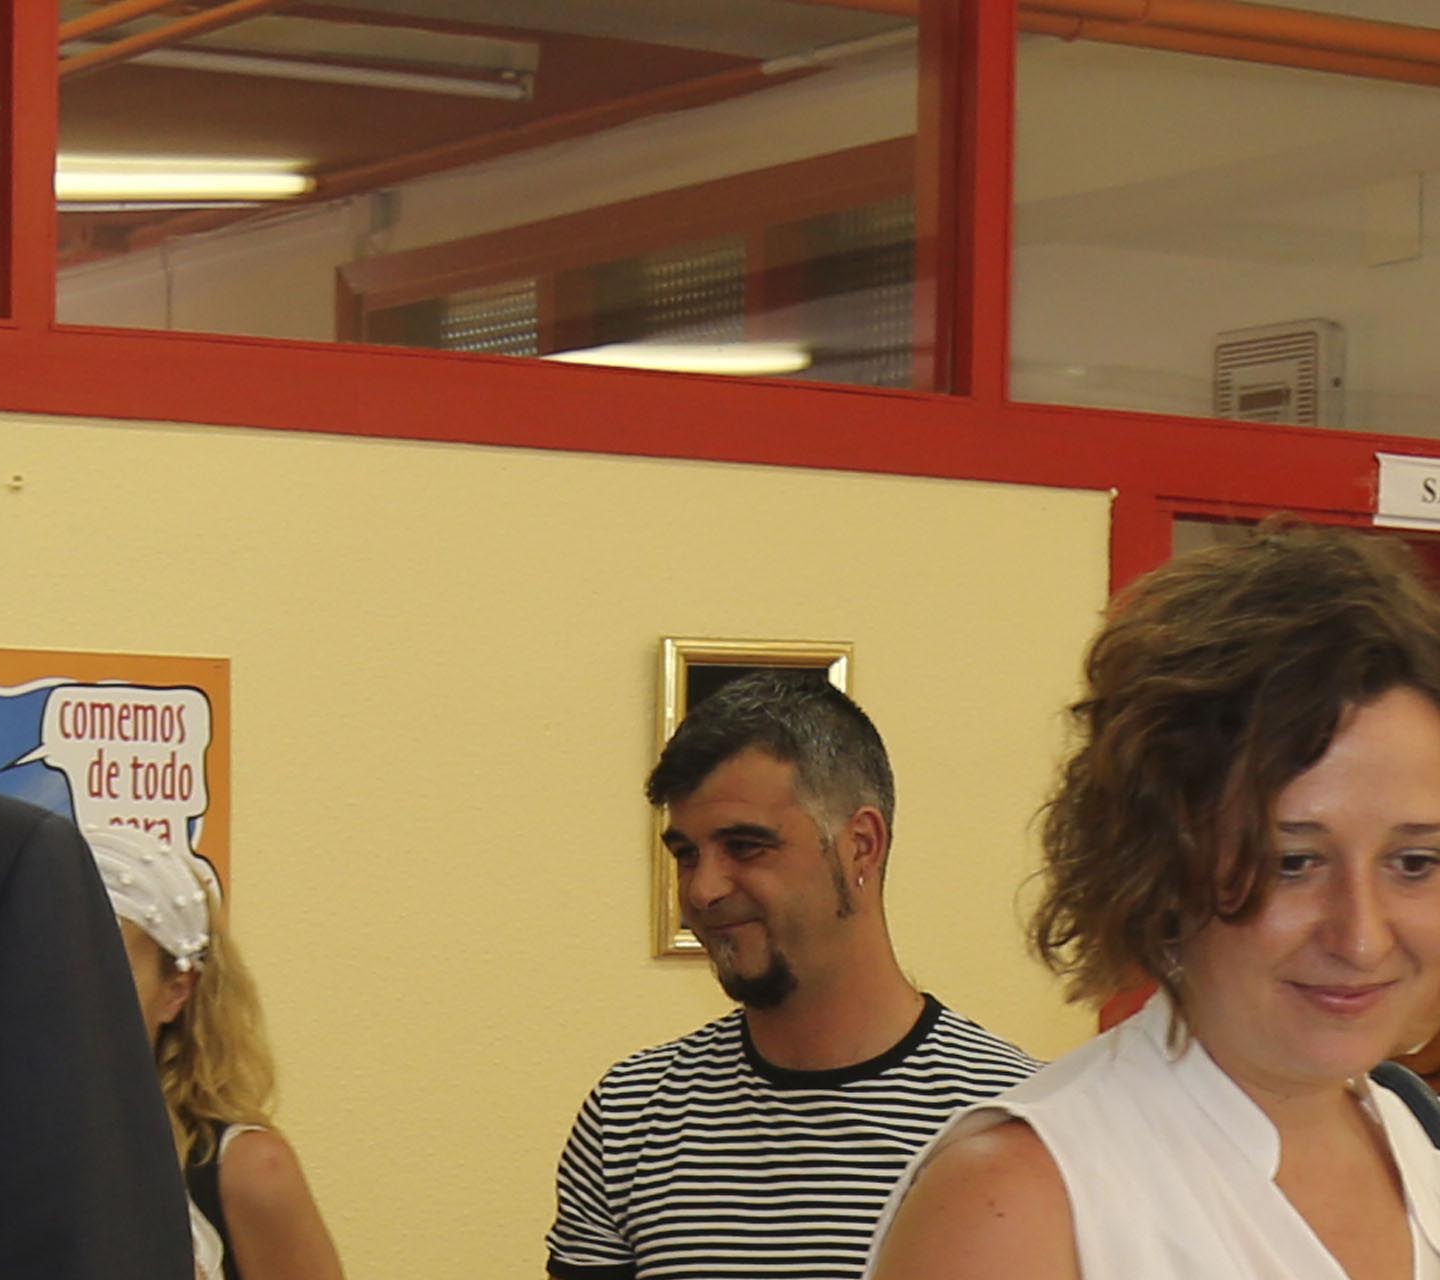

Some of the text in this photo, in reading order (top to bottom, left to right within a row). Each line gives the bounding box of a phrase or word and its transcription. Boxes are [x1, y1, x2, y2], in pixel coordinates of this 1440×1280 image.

[59, 699, 187, 745] comemos
[87, 747, 194, 802] de todo
